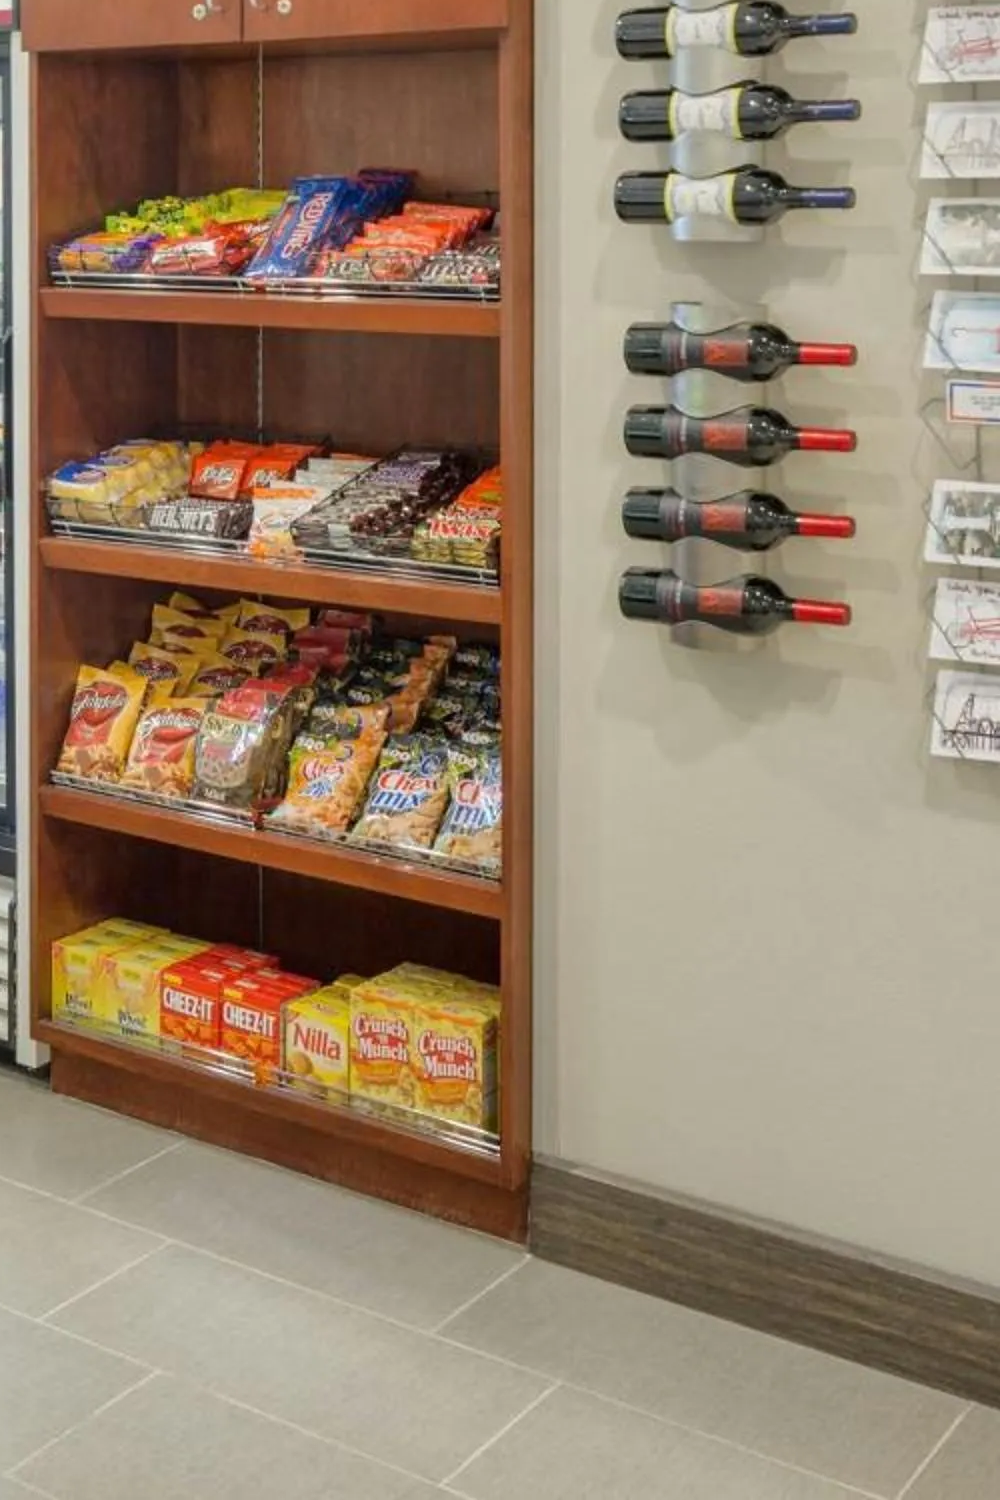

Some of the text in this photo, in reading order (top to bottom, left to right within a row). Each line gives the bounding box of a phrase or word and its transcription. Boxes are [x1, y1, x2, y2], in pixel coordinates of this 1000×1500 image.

[378, 769, 438, 793] Chex
[355, 1011, 410, 1041] Crunch
[292, 1023, 342, 1061] Nilla
[359, 1036, 410, 1064] Munch
[418, 1030, 476, 1058] Crunch
[423, 1055, 476, 1081] Munch
